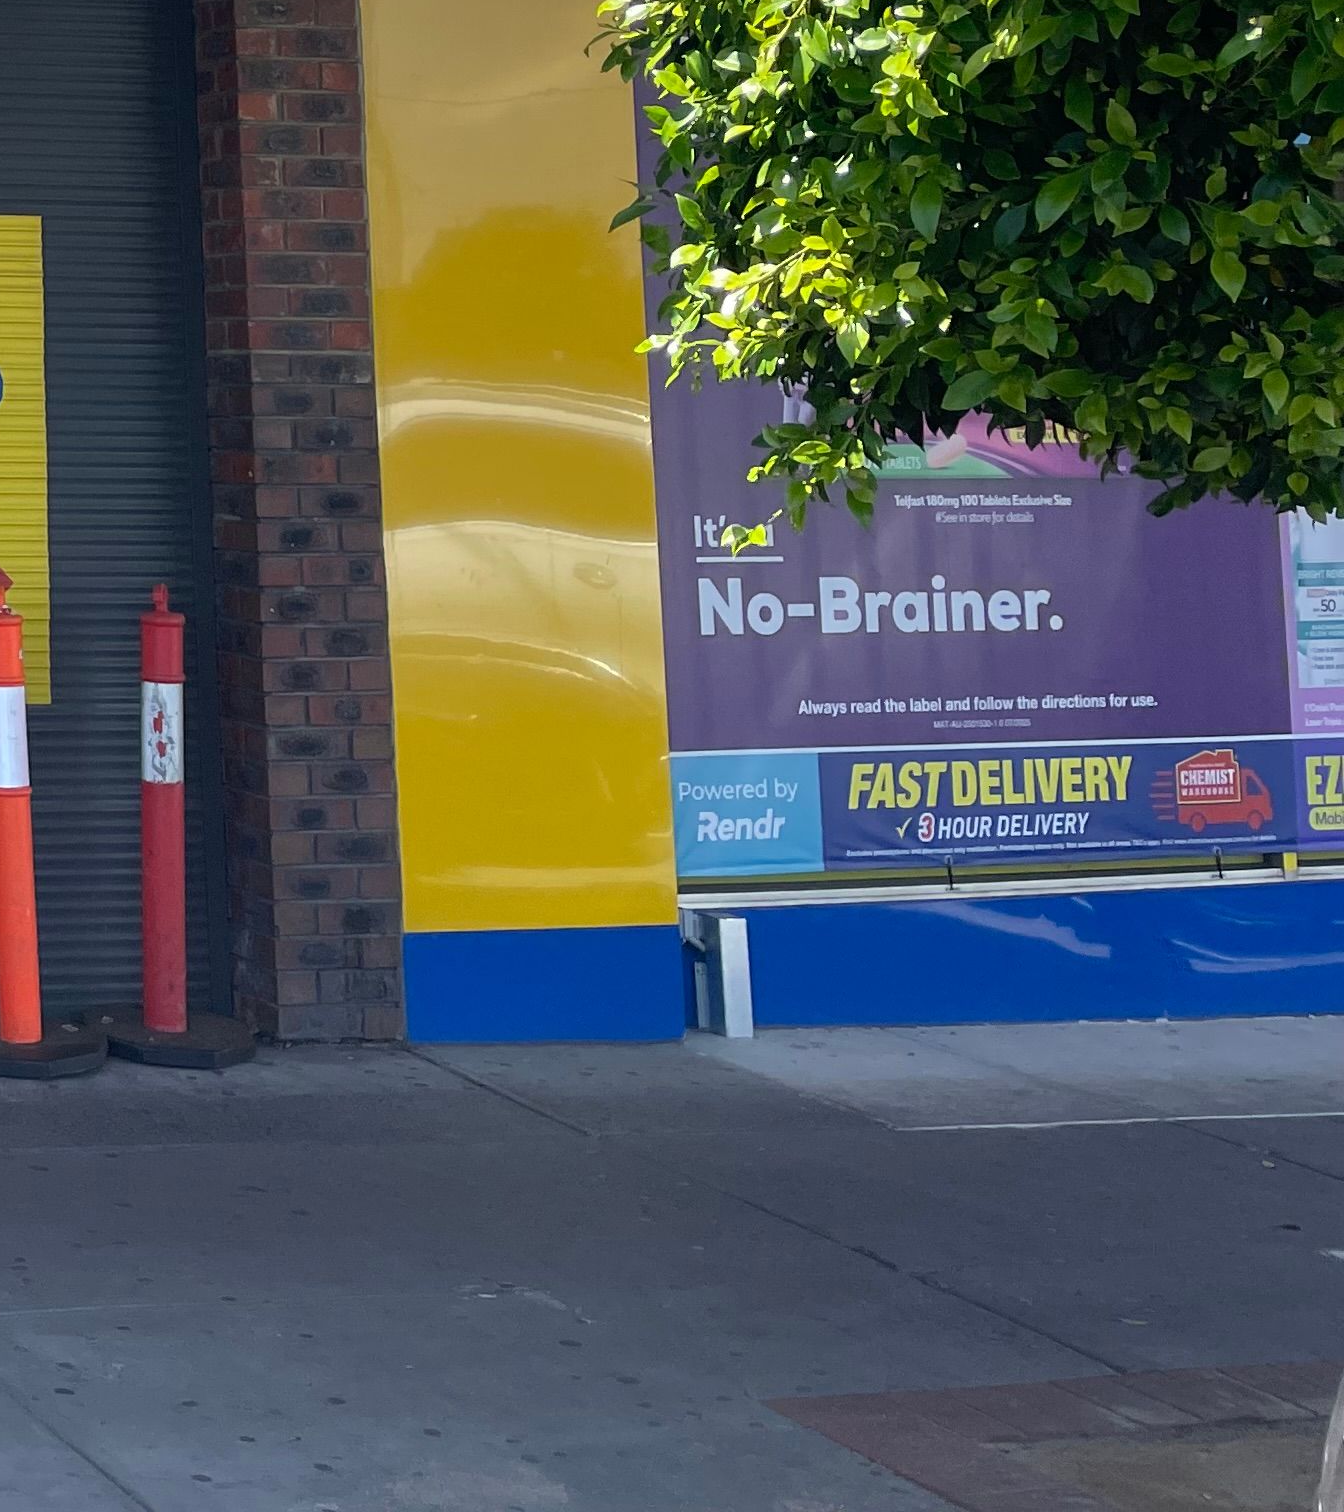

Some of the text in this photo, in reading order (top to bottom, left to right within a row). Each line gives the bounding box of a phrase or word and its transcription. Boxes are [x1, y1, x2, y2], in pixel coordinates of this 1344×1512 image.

[894, 494, 1071, 510] Telfast 180mg 100 Tablets Exclusive Size
[968, 513, 990, 523] store
[991, 512, 1005, 525] for
[1006, 512, 1034, 523] details
[697, 575, 1064, 636] No-Brainer.
[1320, 599, 1336, 612] 50
[798, 694, 1158, 717] Always read the label and follow the directions for use.
[848, 755, 1132, 810] FAST DELIVERY
[1180, 769, 1235, 786] CHEMIST
[678, 777, 799, 802] Powered by
[1181, 786, 1234, 796] WAREHOUSE
[697, 808, 786, 842] Rendr
[917, 812, 1090, 843] 3 HOUR DELIVERY
